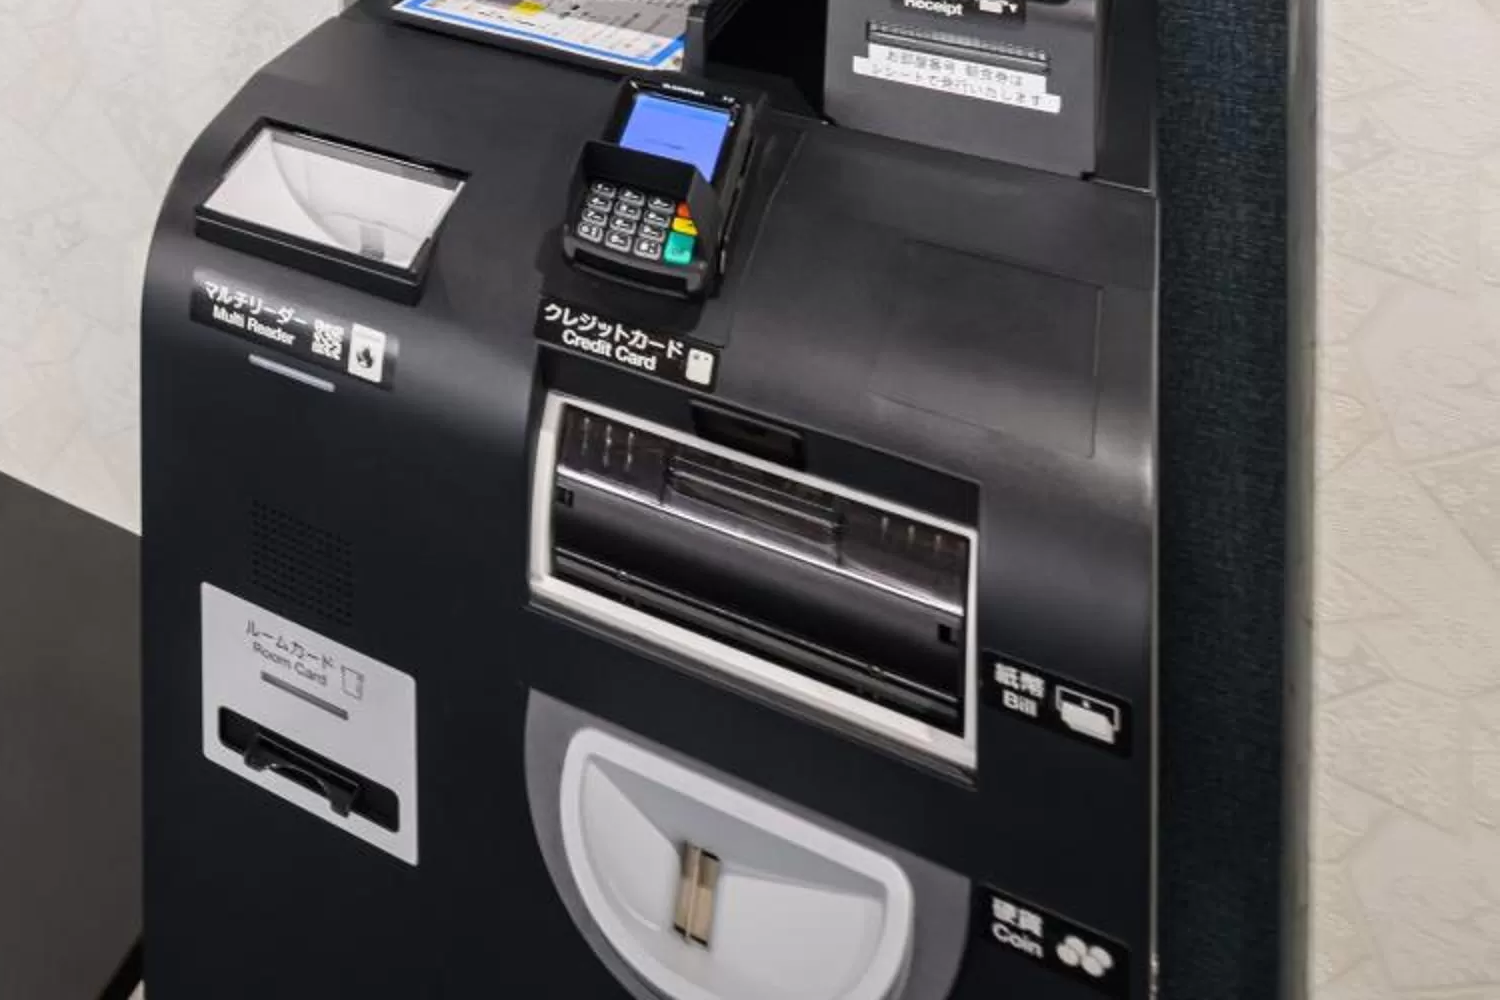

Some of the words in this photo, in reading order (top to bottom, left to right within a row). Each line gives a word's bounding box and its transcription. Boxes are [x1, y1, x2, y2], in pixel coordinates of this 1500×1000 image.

[203, 280, 309, 325] マルチリーダー
[212, 305, 245, 328] Multi
[247, 317, 297, 346] Reader
[544, 303, 685, 359] クレジットカード
[562, 329, 613, 357] Credit
[615, 345, 657, 371] Card
[245, 619, 336, 669] ルームカード
[253, 641, 292, 670] Room
[294, 661, 328, 687] Card
[1002, 688, 1038, 717] Bill
[992, 922, 1043, 960] Coin
